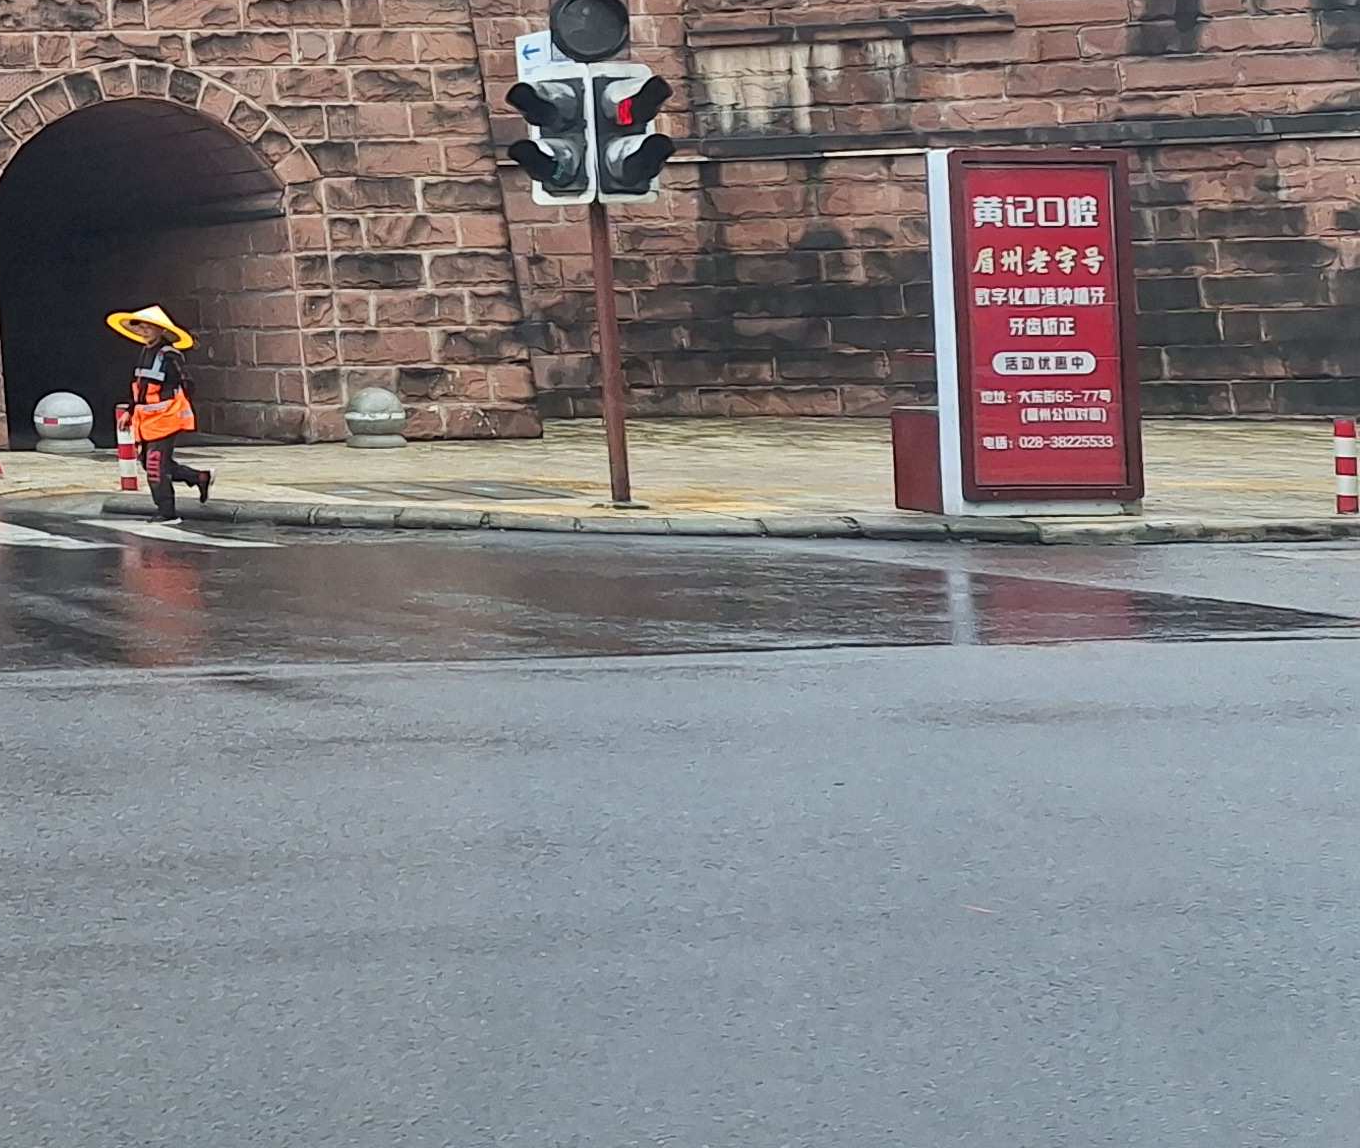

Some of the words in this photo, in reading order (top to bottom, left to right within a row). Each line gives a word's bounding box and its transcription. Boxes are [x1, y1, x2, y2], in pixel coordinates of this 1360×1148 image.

[973, 195, 1099, 227] 黄记口腔
[973, 246, 1105, 275] 眉州老字号
[1005, 356, 1084, 370] 活动优惠中
